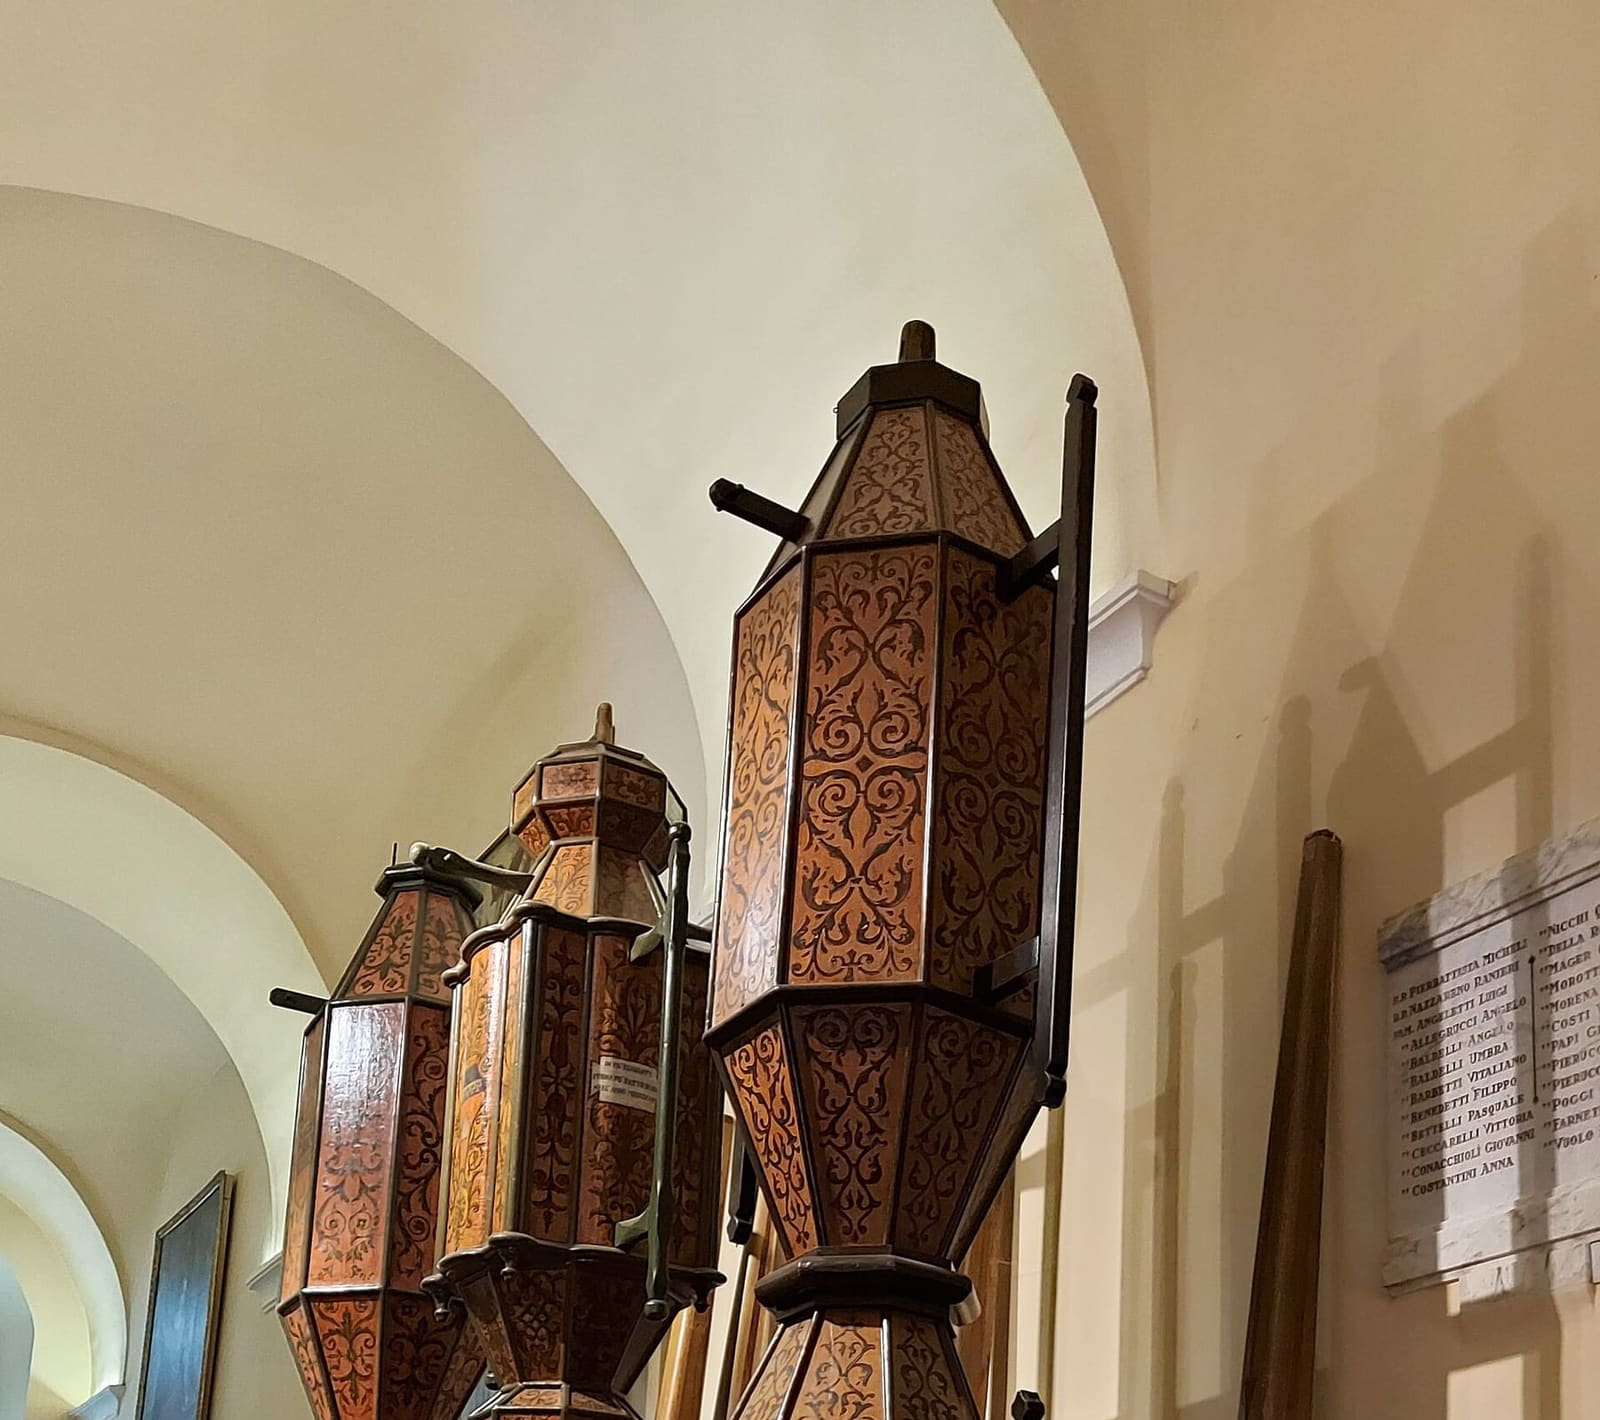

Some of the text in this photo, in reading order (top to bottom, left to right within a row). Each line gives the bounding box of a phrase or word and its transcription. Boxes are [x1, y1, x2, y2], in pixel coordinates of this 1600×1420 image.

[1482, 939, 1528, 966] MICHELI
[1409, 982, 1470, 1015] NAZZARENO
[1474, 961, 1520, 989] RANIERI
[1417, 999, 1474, 1030] ANGELETTI
[1479, 984, 1508, 1006] LUIGI
[1409, 1042, 1462, 1070] BALDELLI
[1468, 1021, 1514, 1047] ANGELO
[1410, 1016, 1478, 1052] ALLEGRUCCI
[1481, 996, 1527, 1023] ANGELO
[1410, 1059, 1463, 1088] BALDELLI
[1469, 1042, 1509, 1064] UMBRA
[1410, 1078, 1462, 1106] BARBETTI
[1466, 1054, 1527, 1082] VITALIANO
[1410, 1094, 1469, 1124] BENEDETTI
[1473, 1077, 1517, 1101] FILIPPO
[1468, 1094, 1525, 1122] PASQUALE
[1411, 1128, 1480, 1160] CECCARELLI
[1482, 1110, 1534, 1134] VITTORIA
[1484, 1128, 1536, 1153] GIOVANNI
[1411, 1168, 1477, 1197] COSTANTINI
[1480, 1156, 1514, 1176] ANNA
